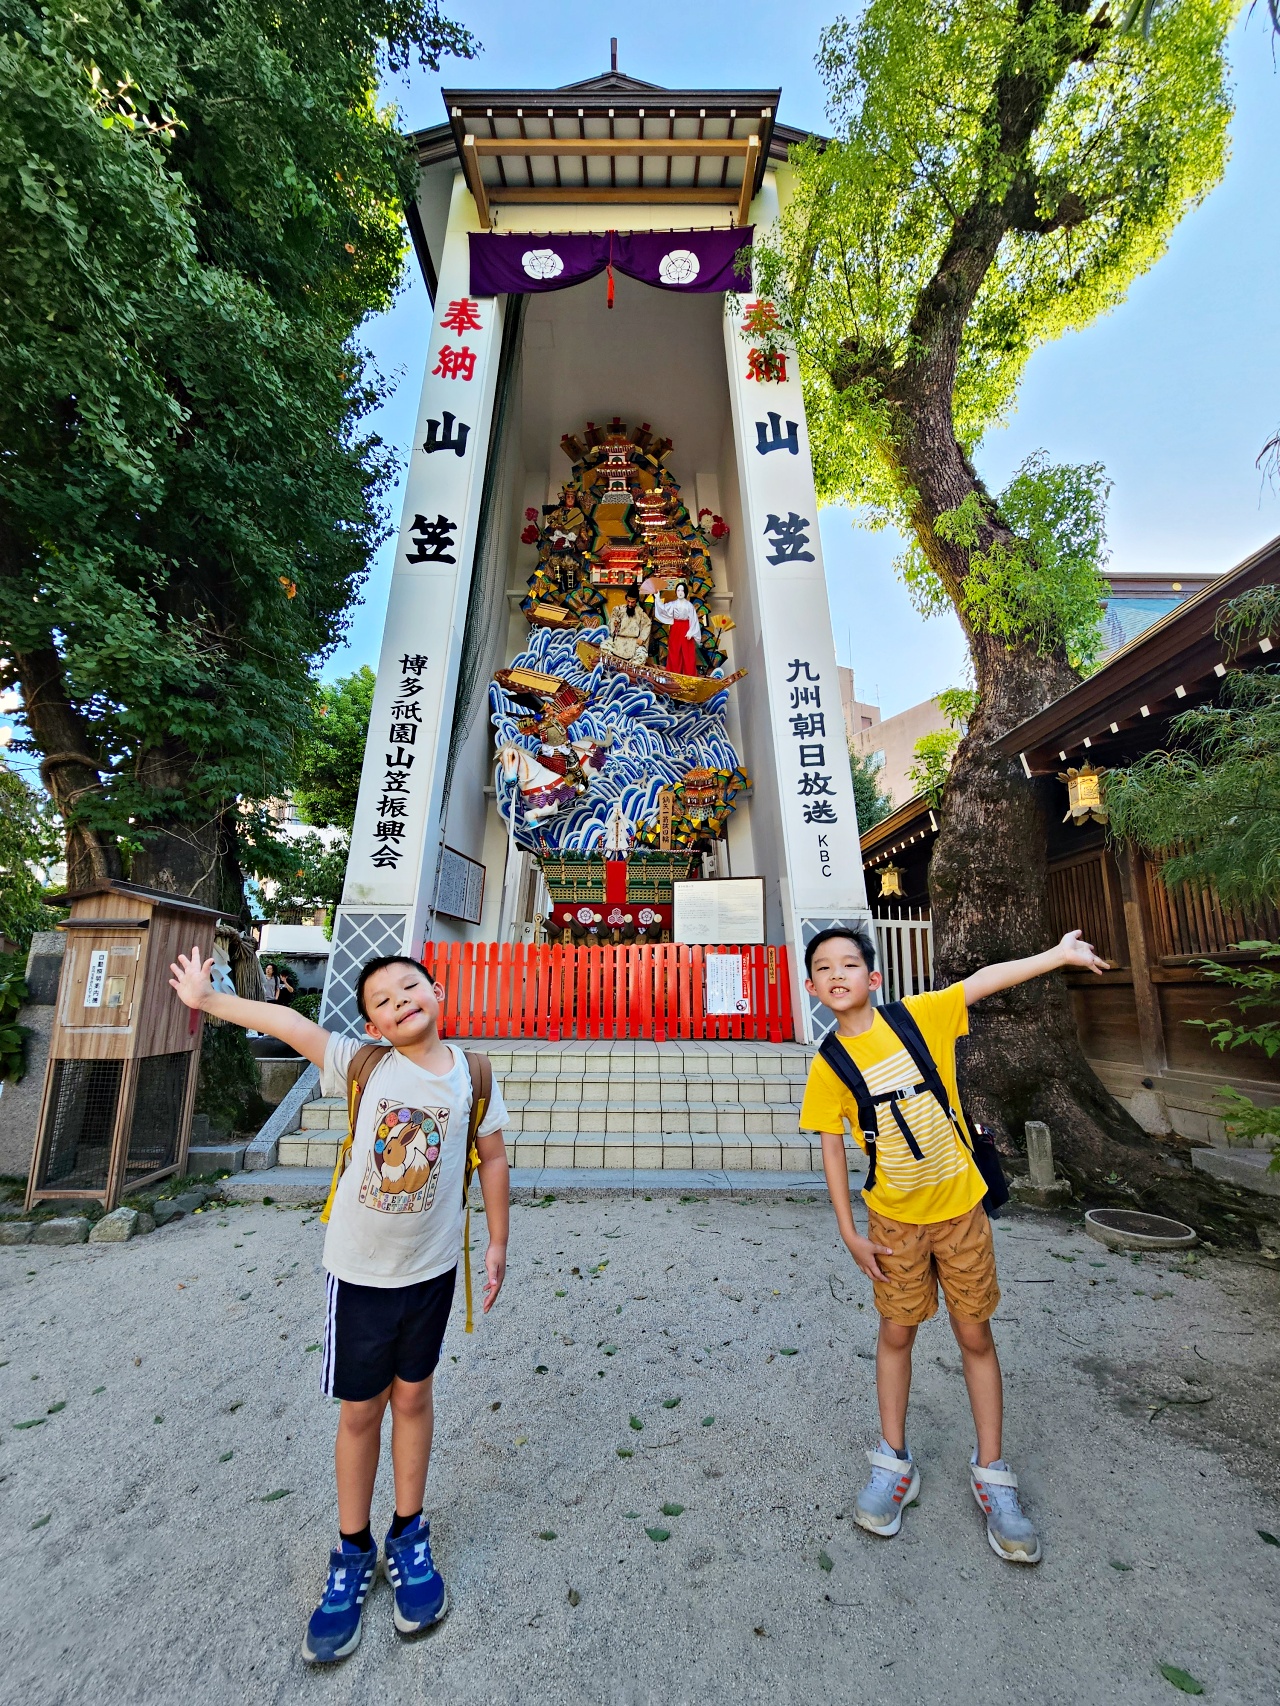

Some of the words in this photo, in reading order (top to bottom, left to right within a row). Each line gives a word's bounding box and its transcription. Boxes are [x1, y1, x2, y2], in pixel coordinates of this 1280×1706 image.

[432, 298, 483, 381] 奉納
[405, 411, 471, 565] 山笠
[755, 411, 815, 566] 山笠
[786, 658, 838, 824] 九州朝日放送
[818, 834, 832, 878] KBC
[370, 1185, 389, 1203] LET'S
[391, 1191, 423, 1204] EVOLVE
[373, 1197, 414, 1211] TOGETHER
